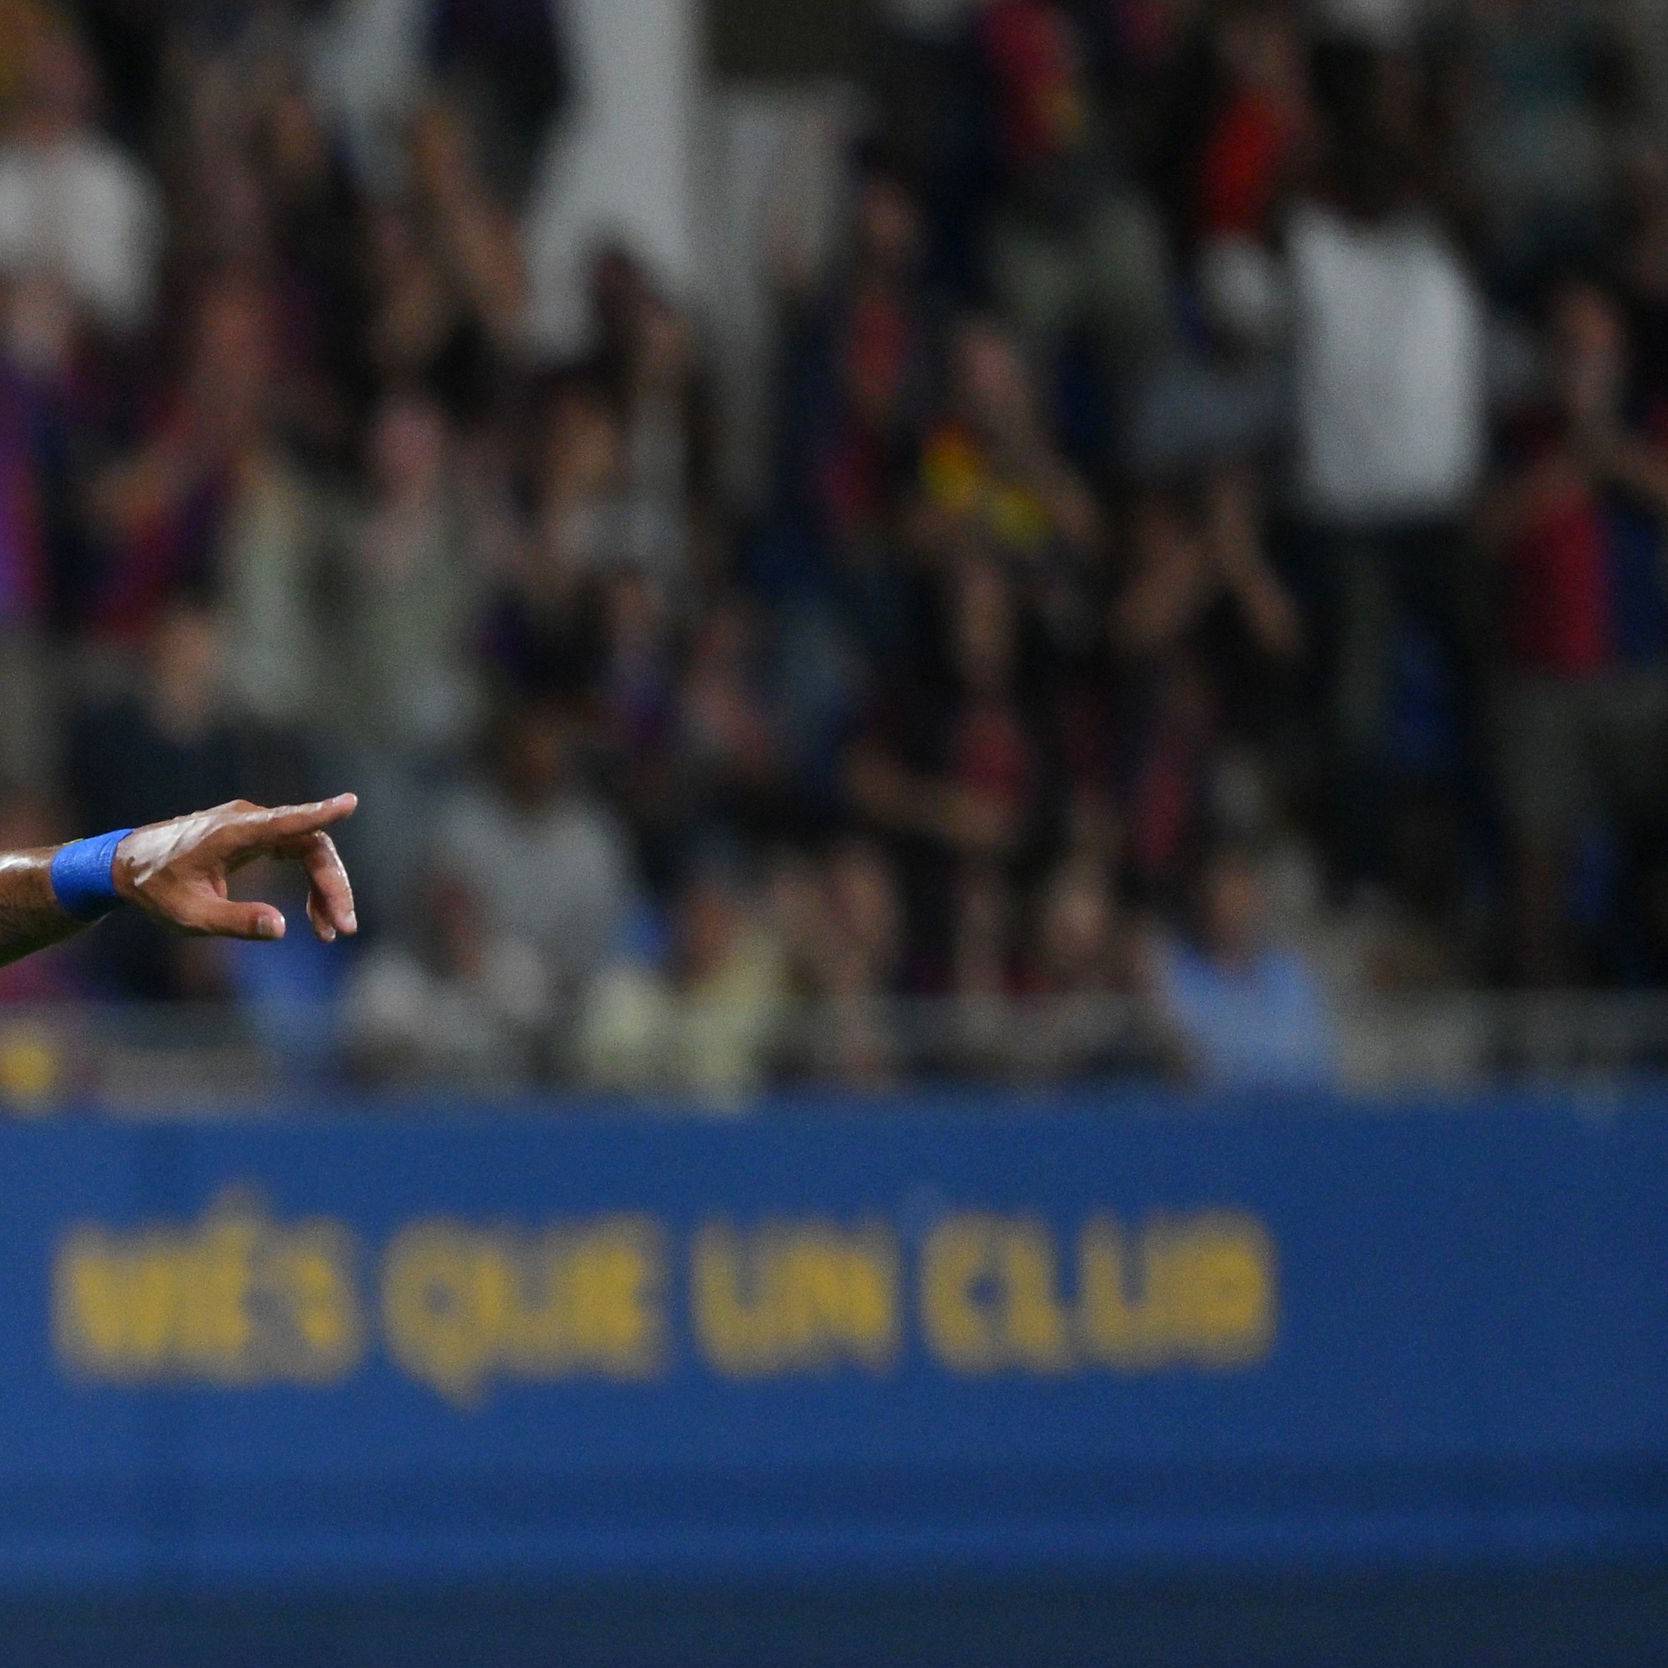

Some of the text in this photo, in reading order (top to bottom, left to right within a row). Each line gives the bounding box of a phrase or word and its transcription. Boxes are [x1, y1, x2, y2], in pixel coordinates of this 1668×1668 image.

[376, 1214, 668, 1403] QUE
[692, 1213, 904, 1378] UN
[920, 1210, 1278, 1375] CLUB
